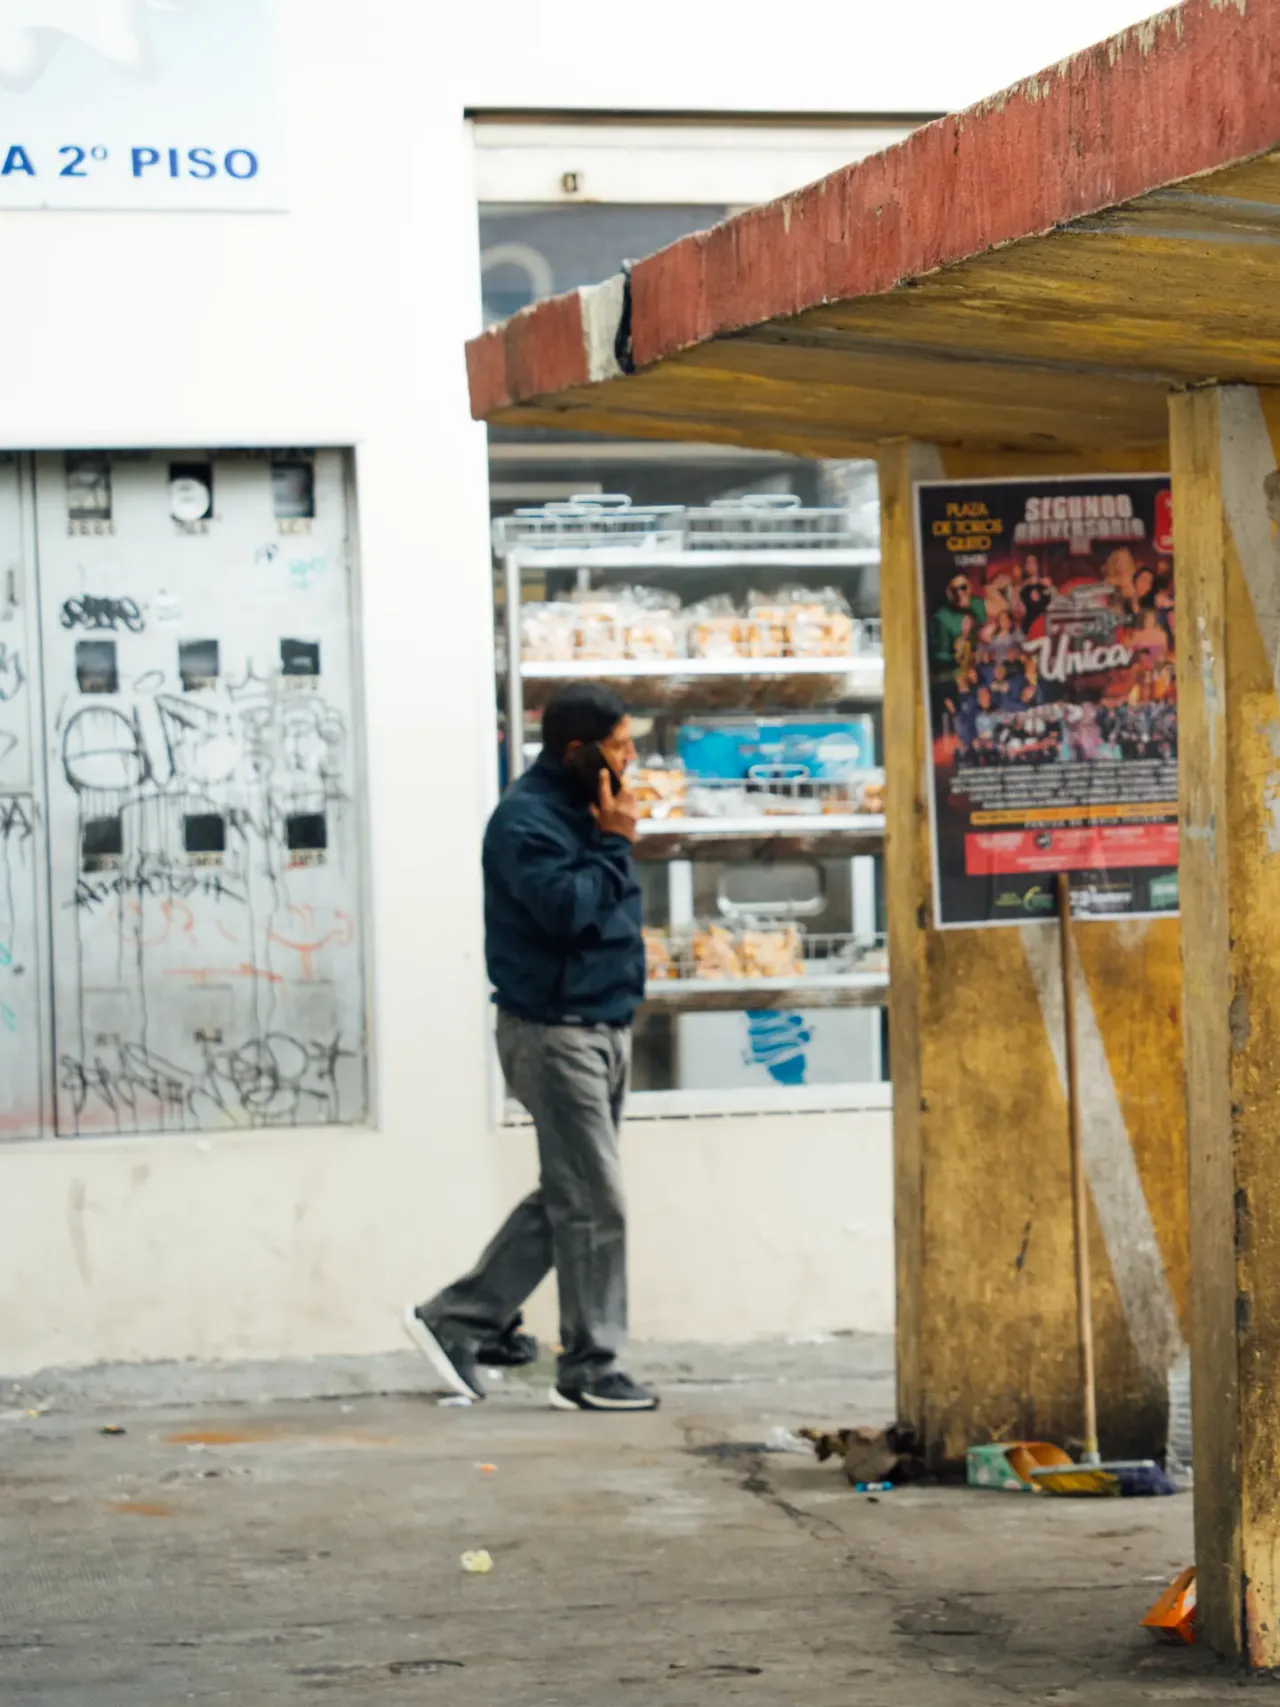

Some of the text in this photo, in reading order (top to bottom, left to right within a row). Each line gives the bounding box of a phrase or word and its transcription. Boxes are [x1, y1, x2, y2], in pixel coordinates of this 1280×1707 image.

[1, 145, 36, 176] A
[131, 147, 259, 179] PISO
[1025, 494, 1133, 521] SEGUNDO
